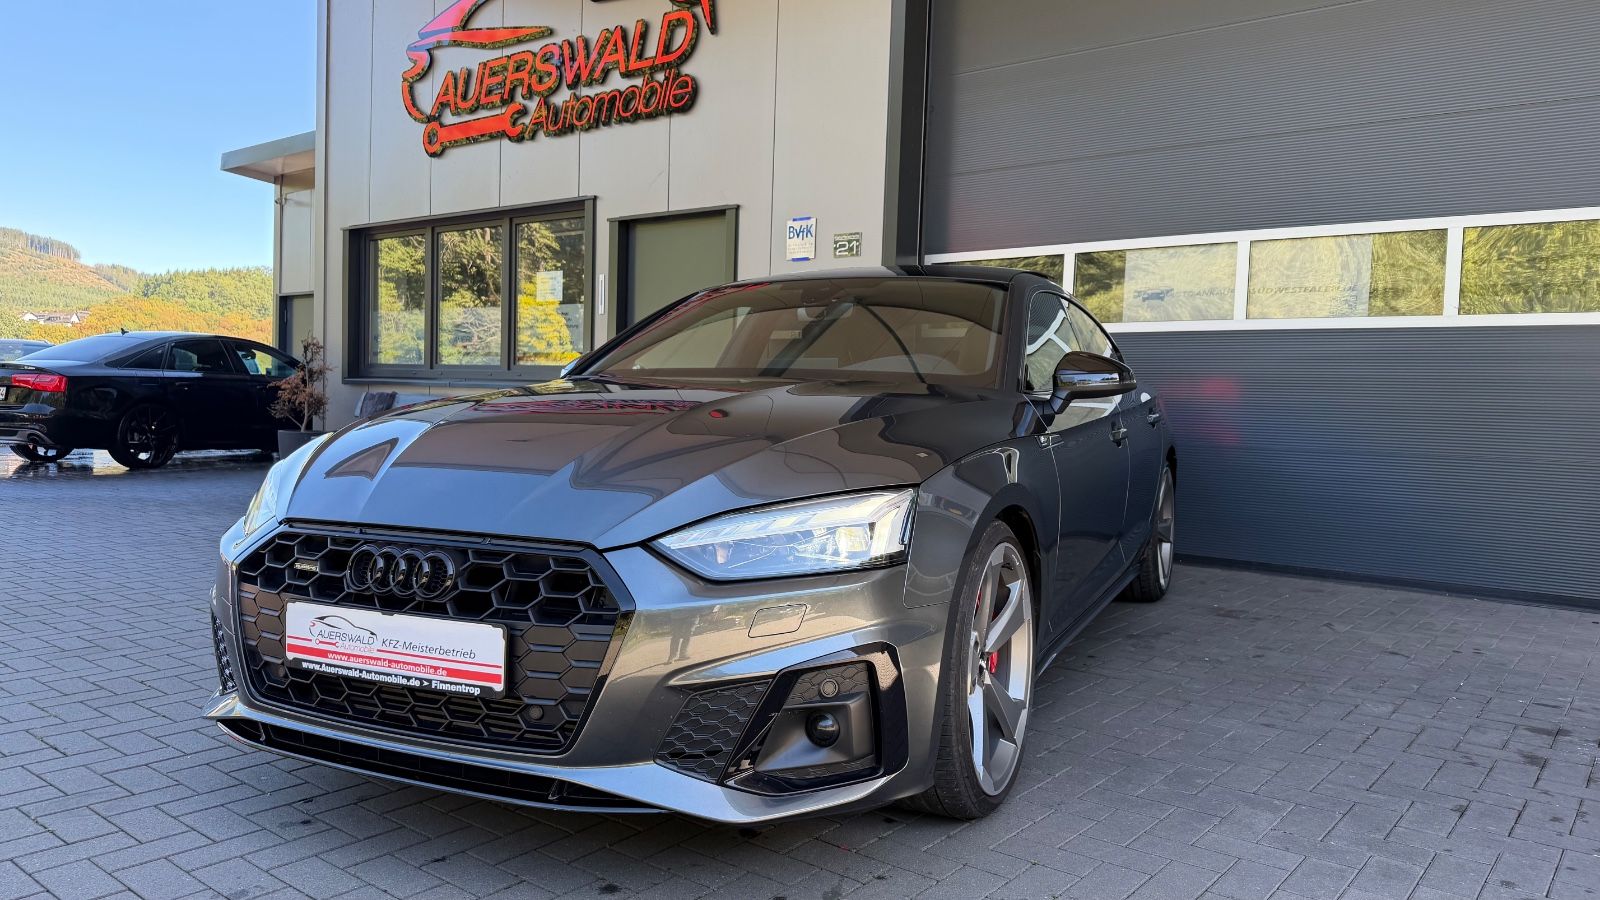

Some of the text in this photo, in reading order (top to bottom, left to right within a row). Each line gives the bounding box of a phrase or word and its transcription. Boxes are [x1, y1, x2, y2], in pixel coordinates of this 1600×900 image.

[430, 8, 700, 116] AUERSWALD
[526, 67, 697, 140] Automobile
[835, 240, 858, 256] 21
[317, 629, 375, 646] AUERSWALD
[381, 637, 477, 660] KFZ-Meisterbetrieb
[327, 652, 448, 677] www.auerswald-automobile.de
[301, 660, 481, 696] www.Auerswald-Automobile.de Finnentrop
